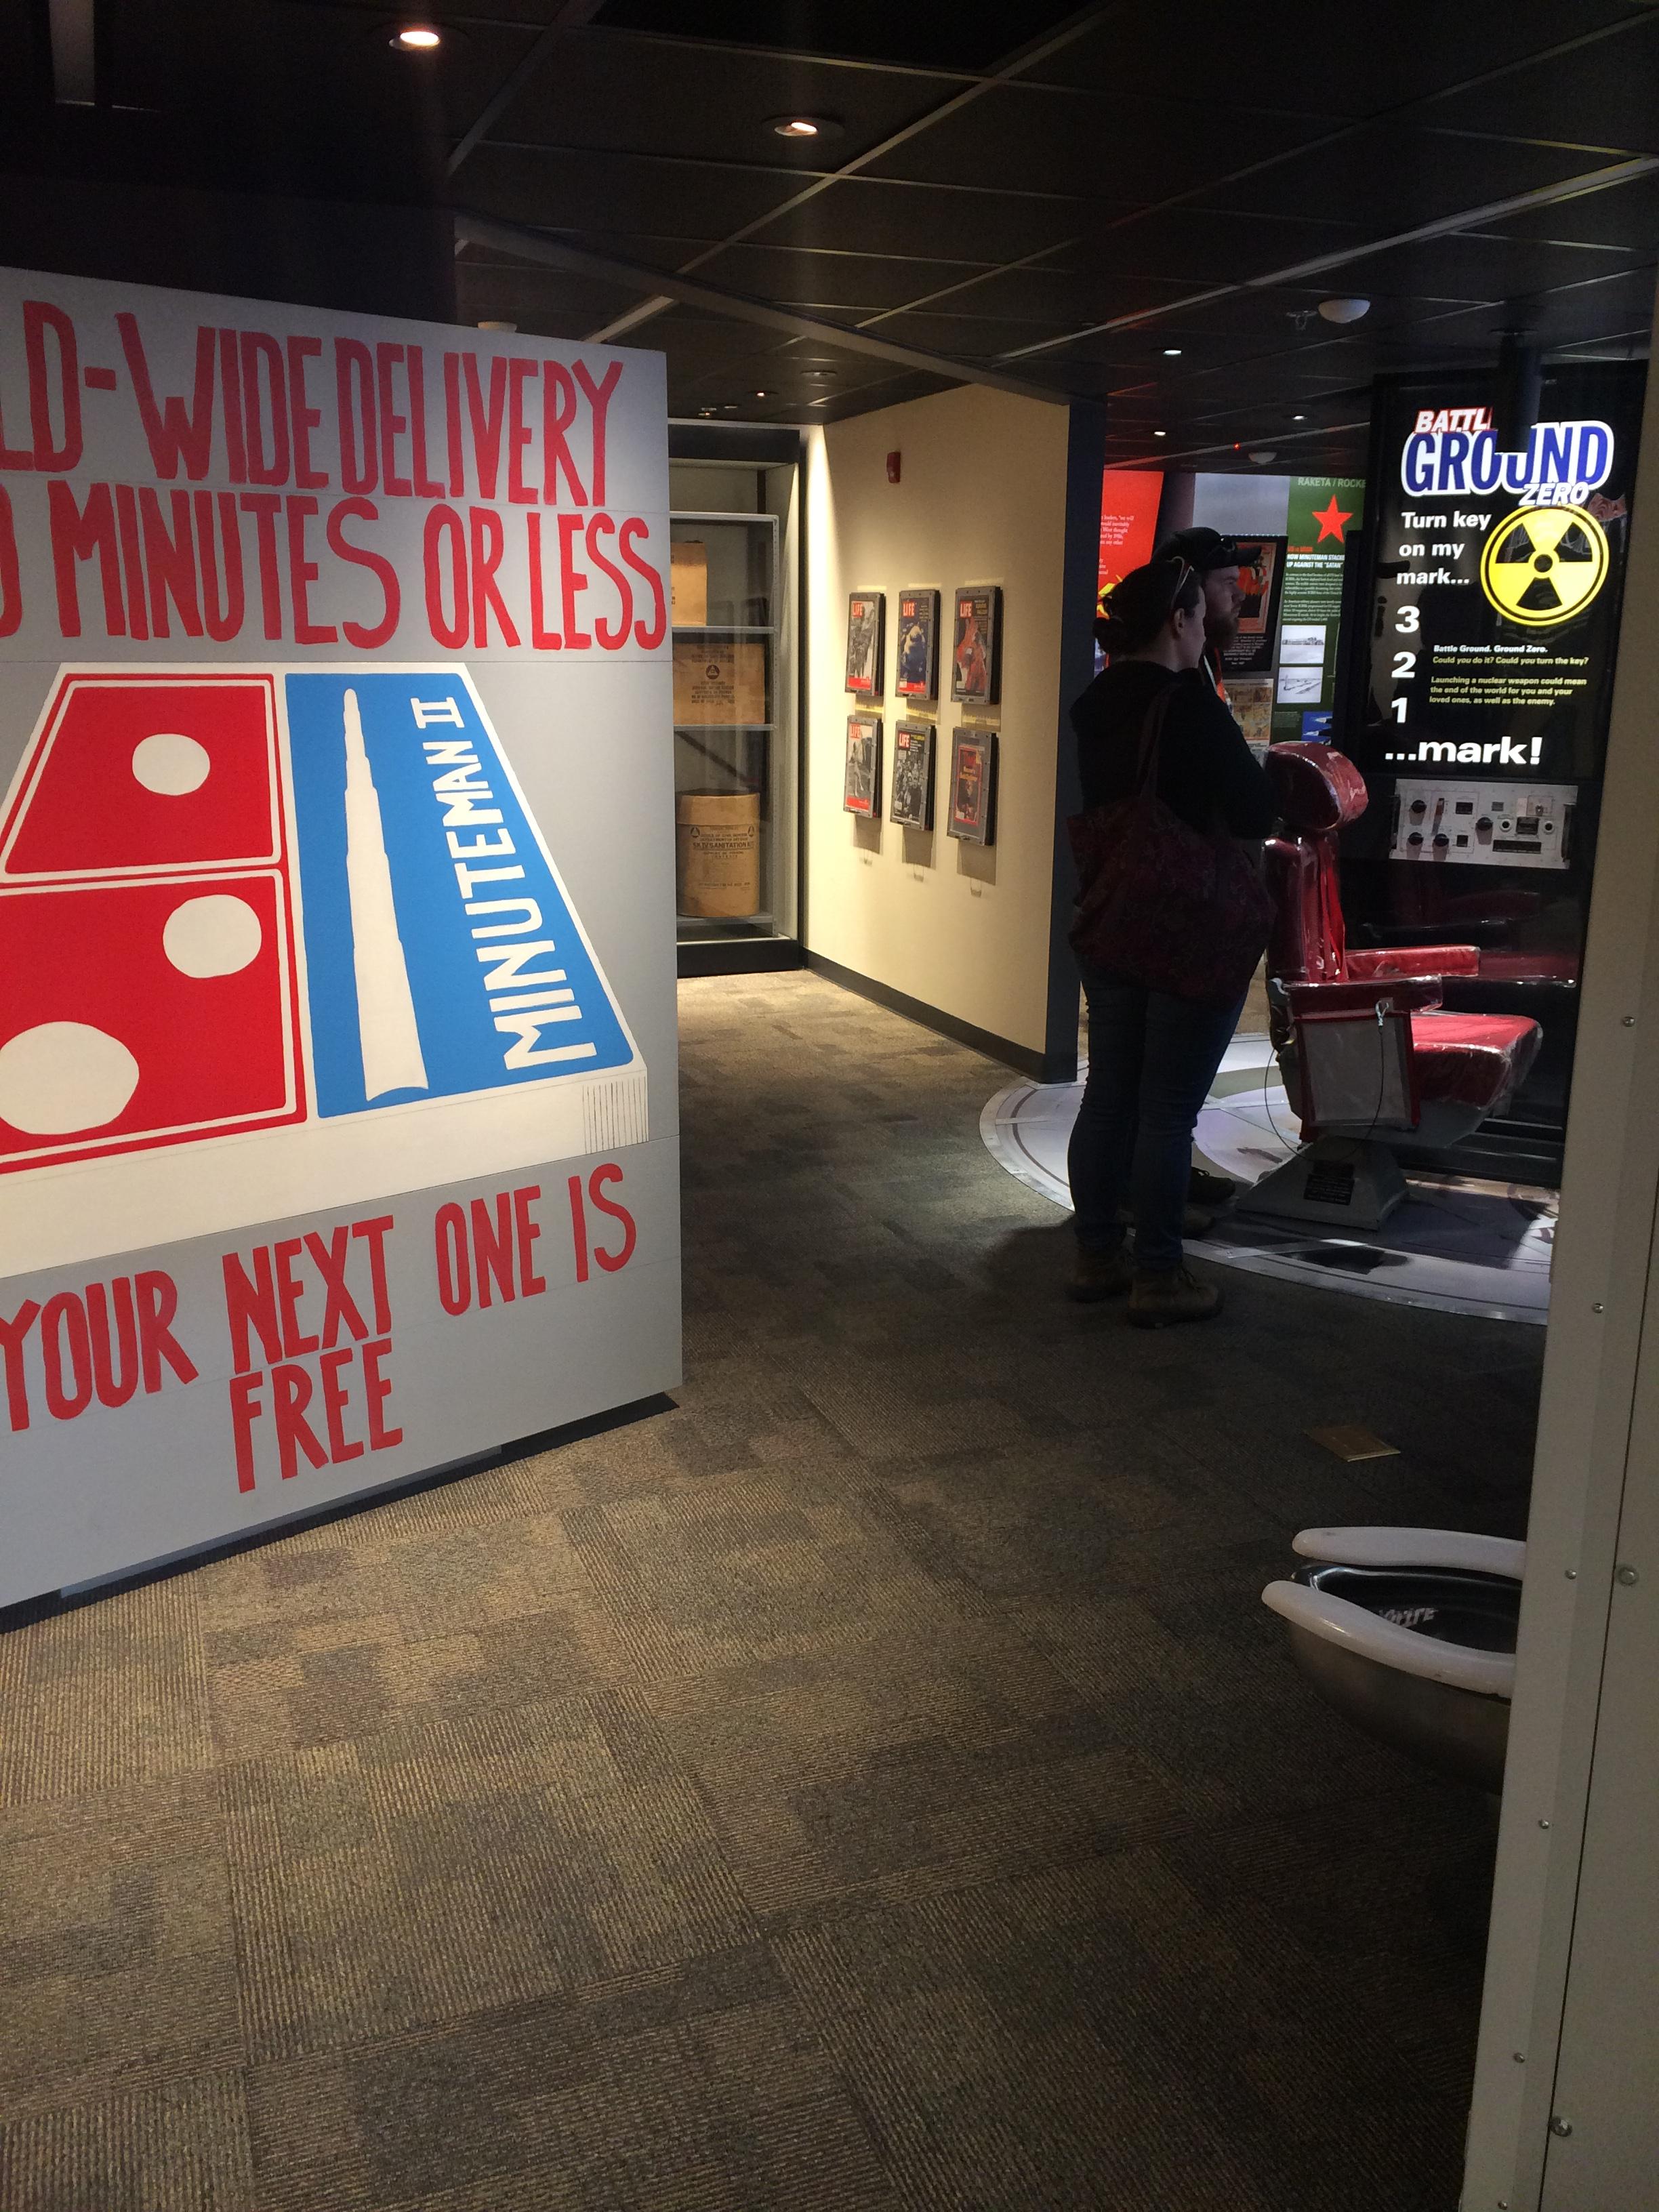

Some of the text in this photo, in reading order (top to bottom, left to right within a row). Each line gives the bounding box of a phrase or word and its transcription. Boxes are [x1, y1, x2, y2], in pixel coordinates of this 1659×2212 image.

[335, 337, 623, 507] DELIVERY
[1414, 407, 1493, 434] BATTL
[1402, 421, 1614, 497] GROUND
[1297, 476, 1331, 487] RAKETA
[1518, 482, 1591, 506] ZERO
[1401, 511, 1492, 531] Turn key
[1399, 544, 1465, 561] on my
[47, 479, 401, 649] MINUTES
[424, 504, 522, 650] OR
[526, 512, 667, 651] LESS
[1396, 568, 1470, 586] mark...
[853, 602, 863, 617] LIFE
[903, 602, 914, 617] LIFE
[960, 603, 972, 617] LIFE
[1395, 606, 1420, 633] 3
[1391, 651, 1416, 678] 2
[1433, 656, 1455, 664] Could
[1521, 657, 1536, 665] you
[1570, 657, 1589, 666] key?
[1431, 676, 1470, 684] Launching
[1391, 697, 1408, 723] 1
[1527, 699, 1556, 707] enemy.
[851, 724, 861, 738] LIFE
[899, 733, 910, 747] LIFE
[1385, 736, 1543, 766] ...mark!
[411, 696, 598, 1071] MINUTEMAN II
[0, 1163, 637, 1432] YOUR NEXT ONE IS
[229, 1338, 404, 1494] FREE
